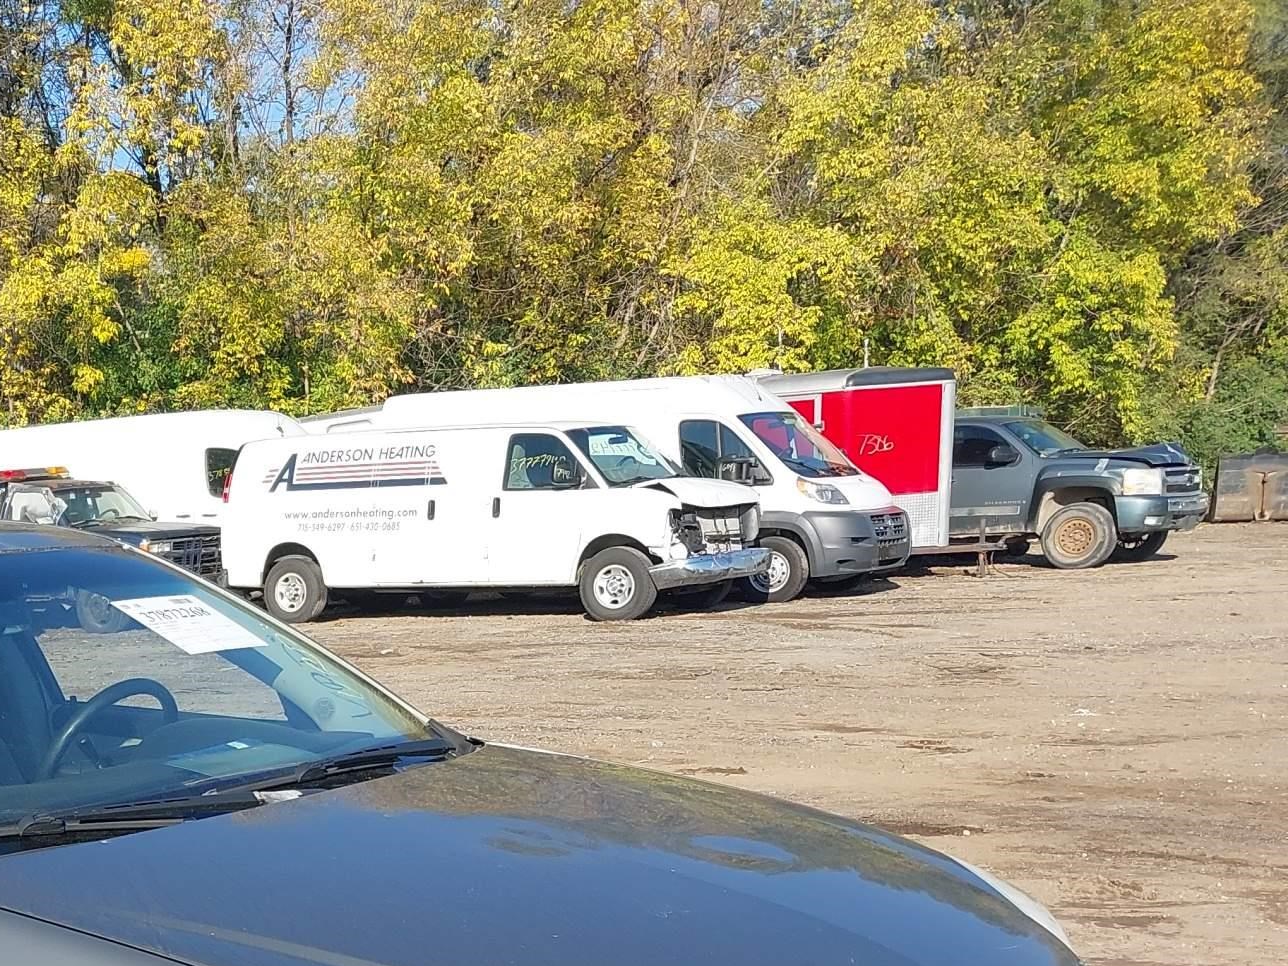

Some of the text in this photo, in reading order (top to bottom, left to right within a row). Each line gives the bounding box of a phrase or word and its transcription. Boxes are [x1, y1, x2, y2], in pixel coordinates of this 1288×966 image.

[301, 444, 436, 464] ANDERSON HEATING
[283, 507, 418, 520] www.andersonheating.com
